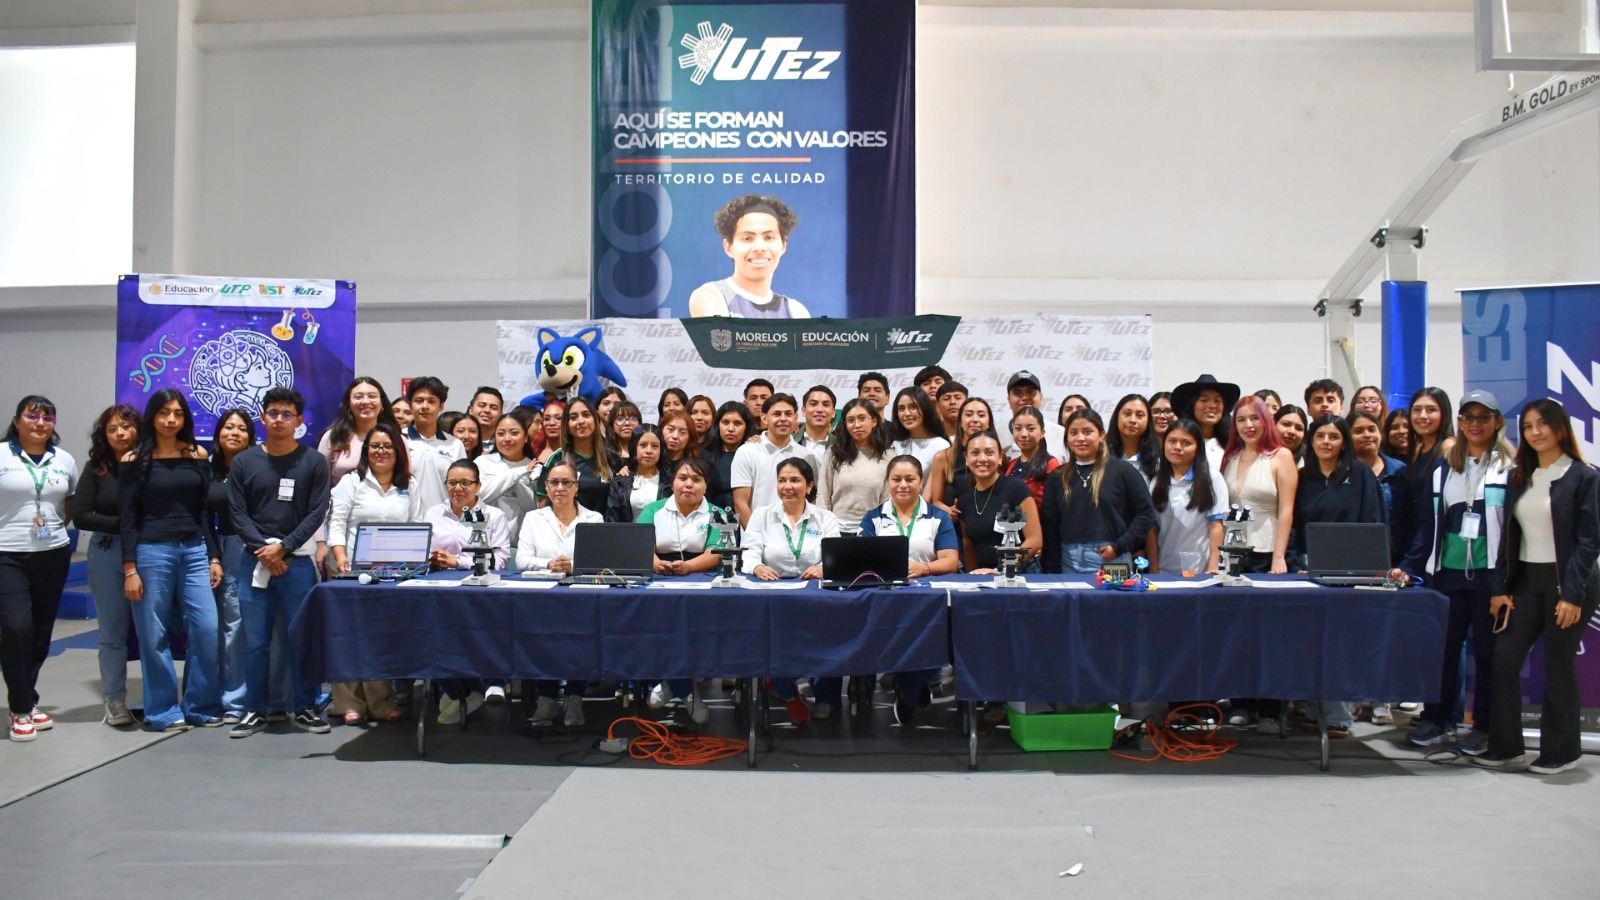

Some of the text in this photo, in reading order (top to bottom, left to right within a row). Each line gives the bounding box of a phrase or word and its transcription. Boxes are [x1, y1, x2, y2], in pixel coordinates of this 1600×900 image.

[713, 37, 841, 81] UTEZ
[1502, 99, 1527, 123] B.M.
[1529, 80, 1568, 109] GOLD
[1569, 83, 1579, 94] BY
[613, 109, 784, 131] AQUÍ SE FORMAN
[613, 131, 888, 150] CAMPEONES CON VALORES
[615, 173, 825, 185] TERRITORIO DE CALIDAD
[164, 284, 214, 293] Educación
[735, 331, 788, 343] MORELOS
[801, 330, 870, 342] EDUCACIÓN
[896, 330, 934, 345] UTEZ
[505, 350, 535, 365] UTE
